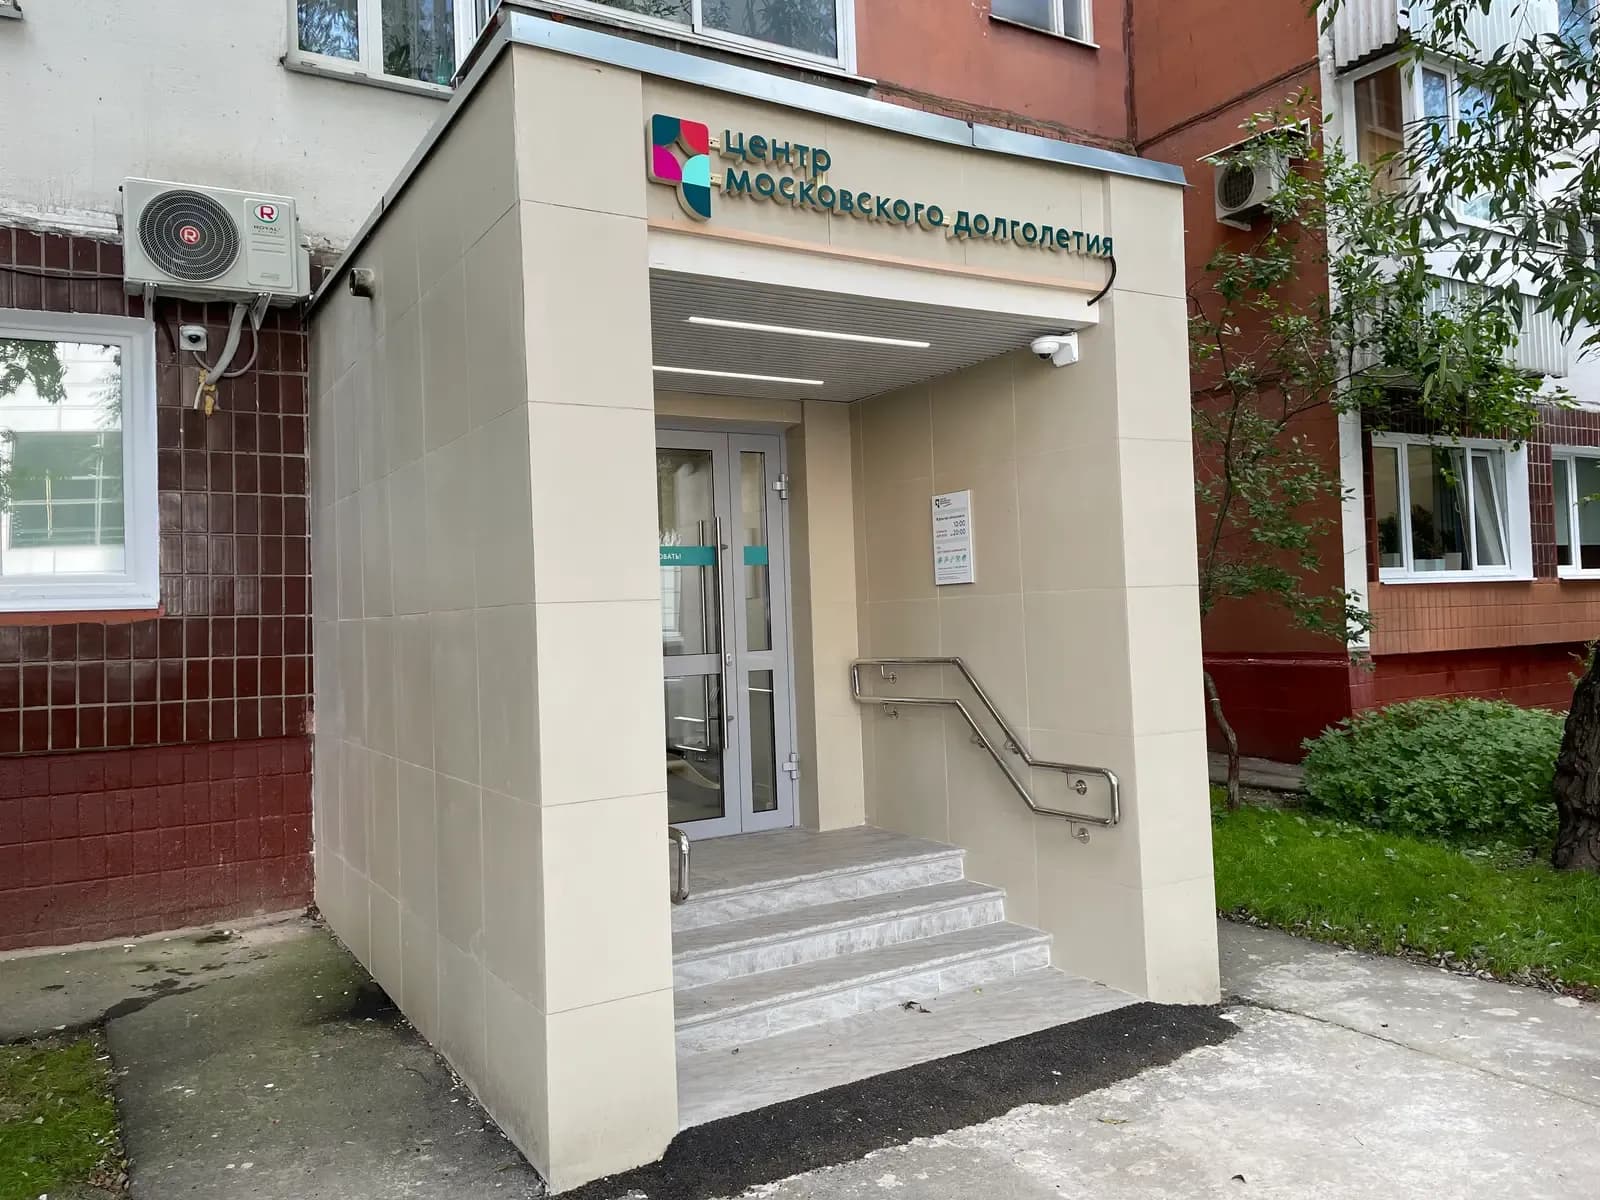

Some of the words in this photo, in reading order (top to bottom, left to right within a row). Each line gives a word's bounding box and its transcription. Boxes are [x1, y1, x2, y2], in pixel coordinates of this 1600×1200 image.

[724, 129, 833, 174] центр
[725, 167, 945, 227] московского
[953, 209, 1115, 256] долголетия
